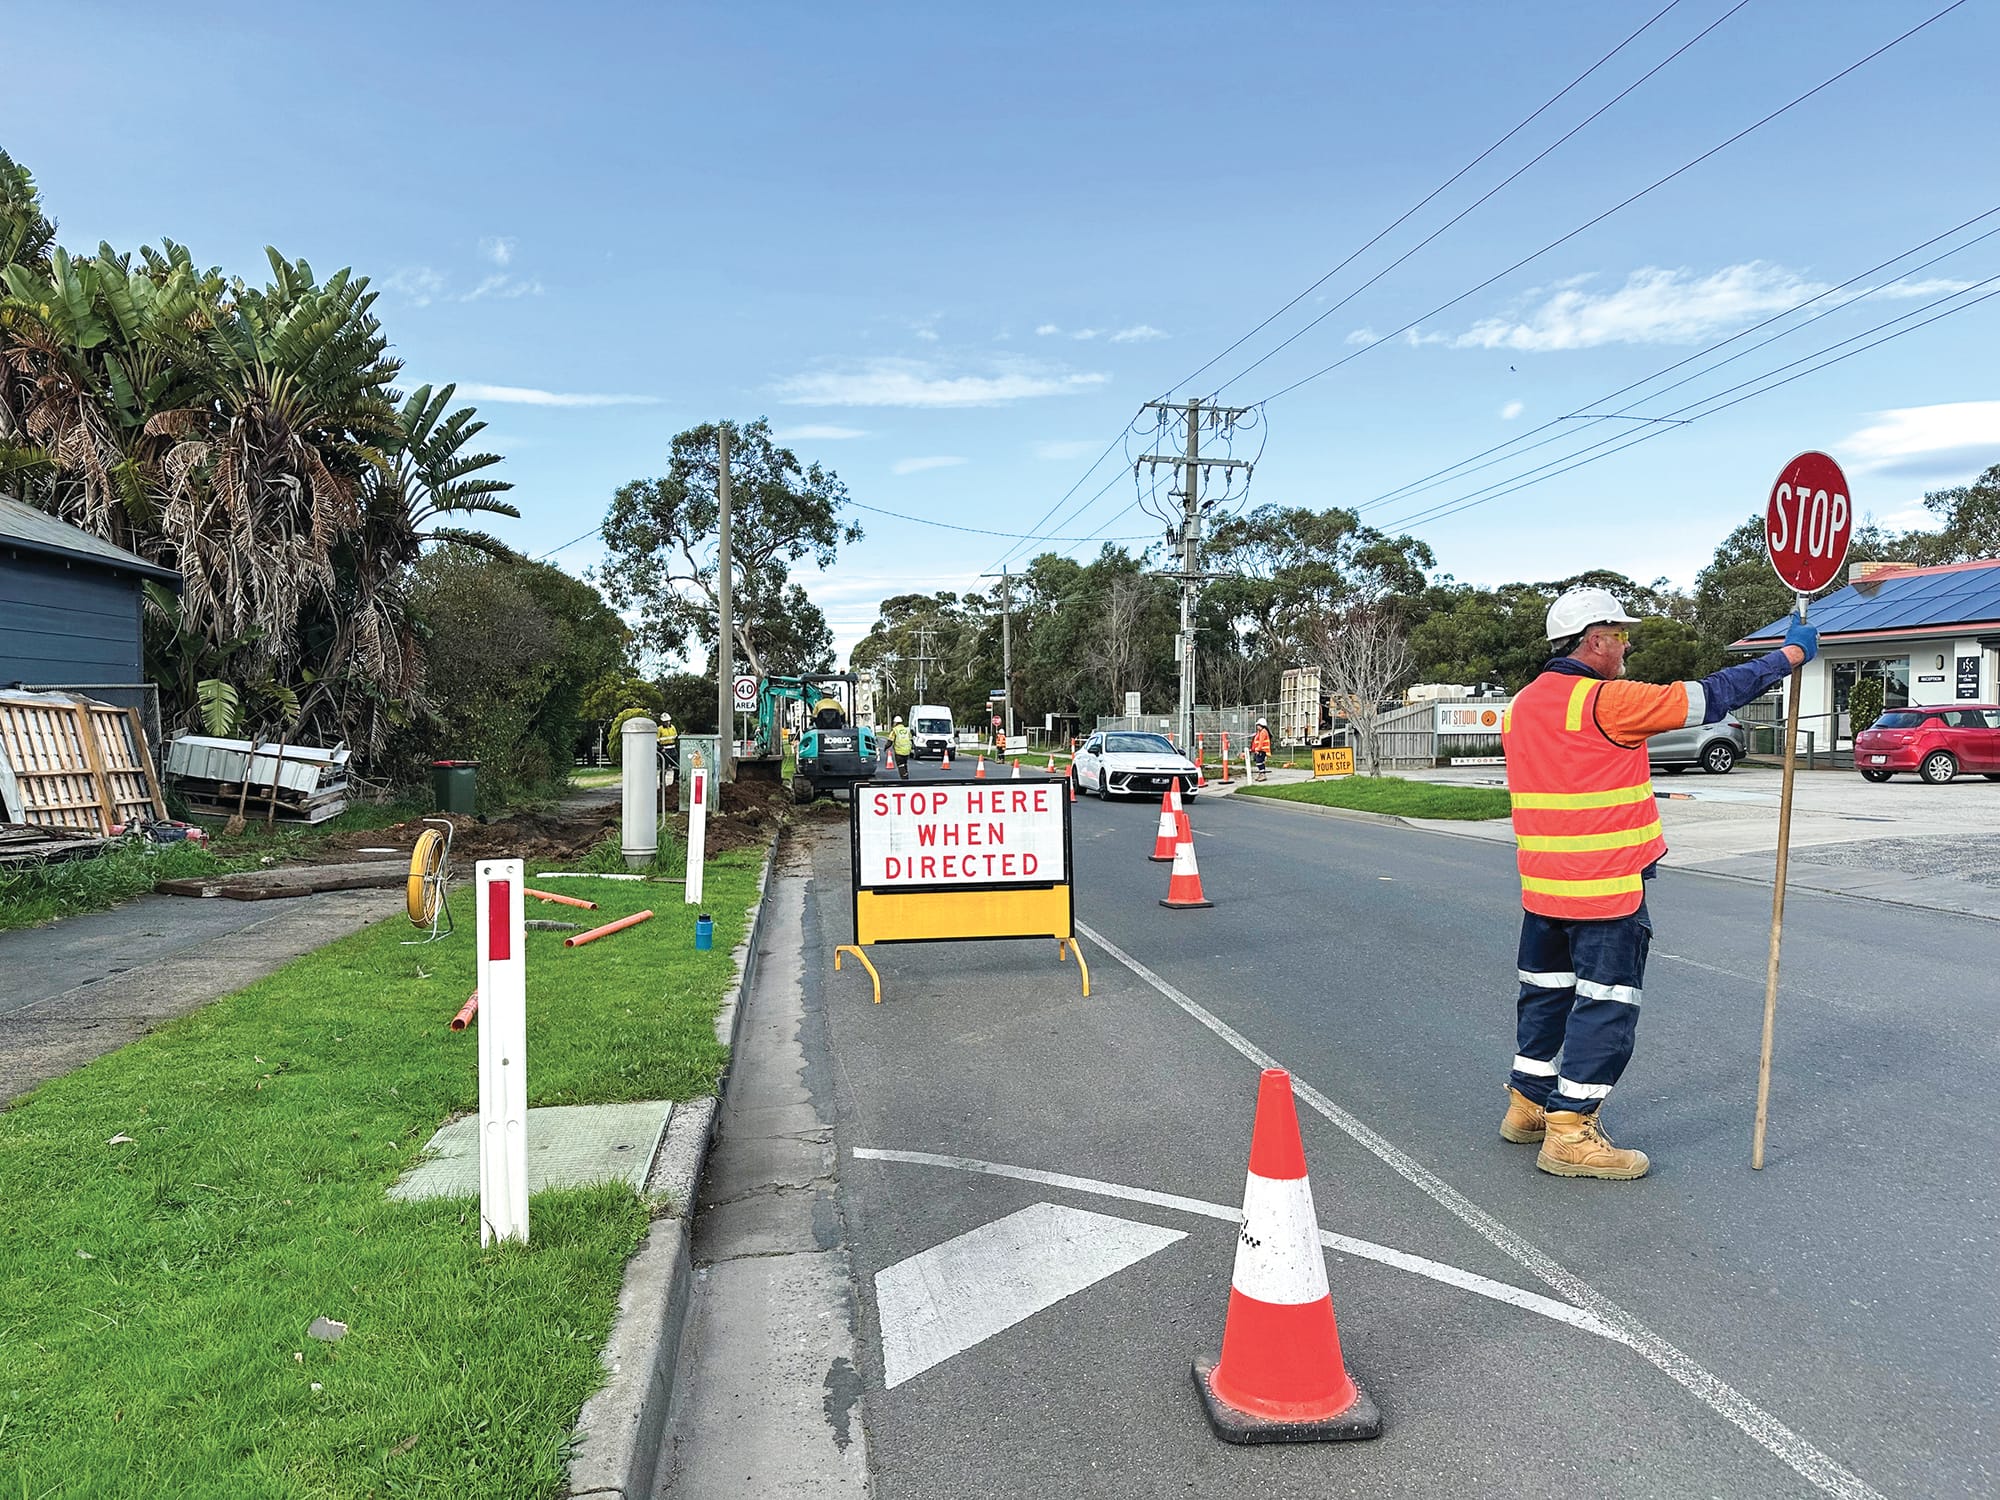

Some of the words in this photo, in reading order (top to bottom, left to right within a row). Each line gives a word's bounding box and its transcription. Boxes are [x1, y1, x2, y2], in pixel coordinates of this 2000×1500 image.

[1771, 482, 1848, 559] STOP
[738, 684, 754, 695] 40
[1441, 710, 1452, 725] PIT
[1453, 710, 1478, 725] STUDIO
[1320, 751, 1346, 761] WATCH
[1316, 762, 1334, 771] YOUR
[1335, 761, 1351, 771] STEP
[873, 792, 948, 816] STOP
[967, 790, 1048, 813] HERE
[917, 822, 1004, 846] WHEN
[885, 853, 1038, 879] DIRECTED
